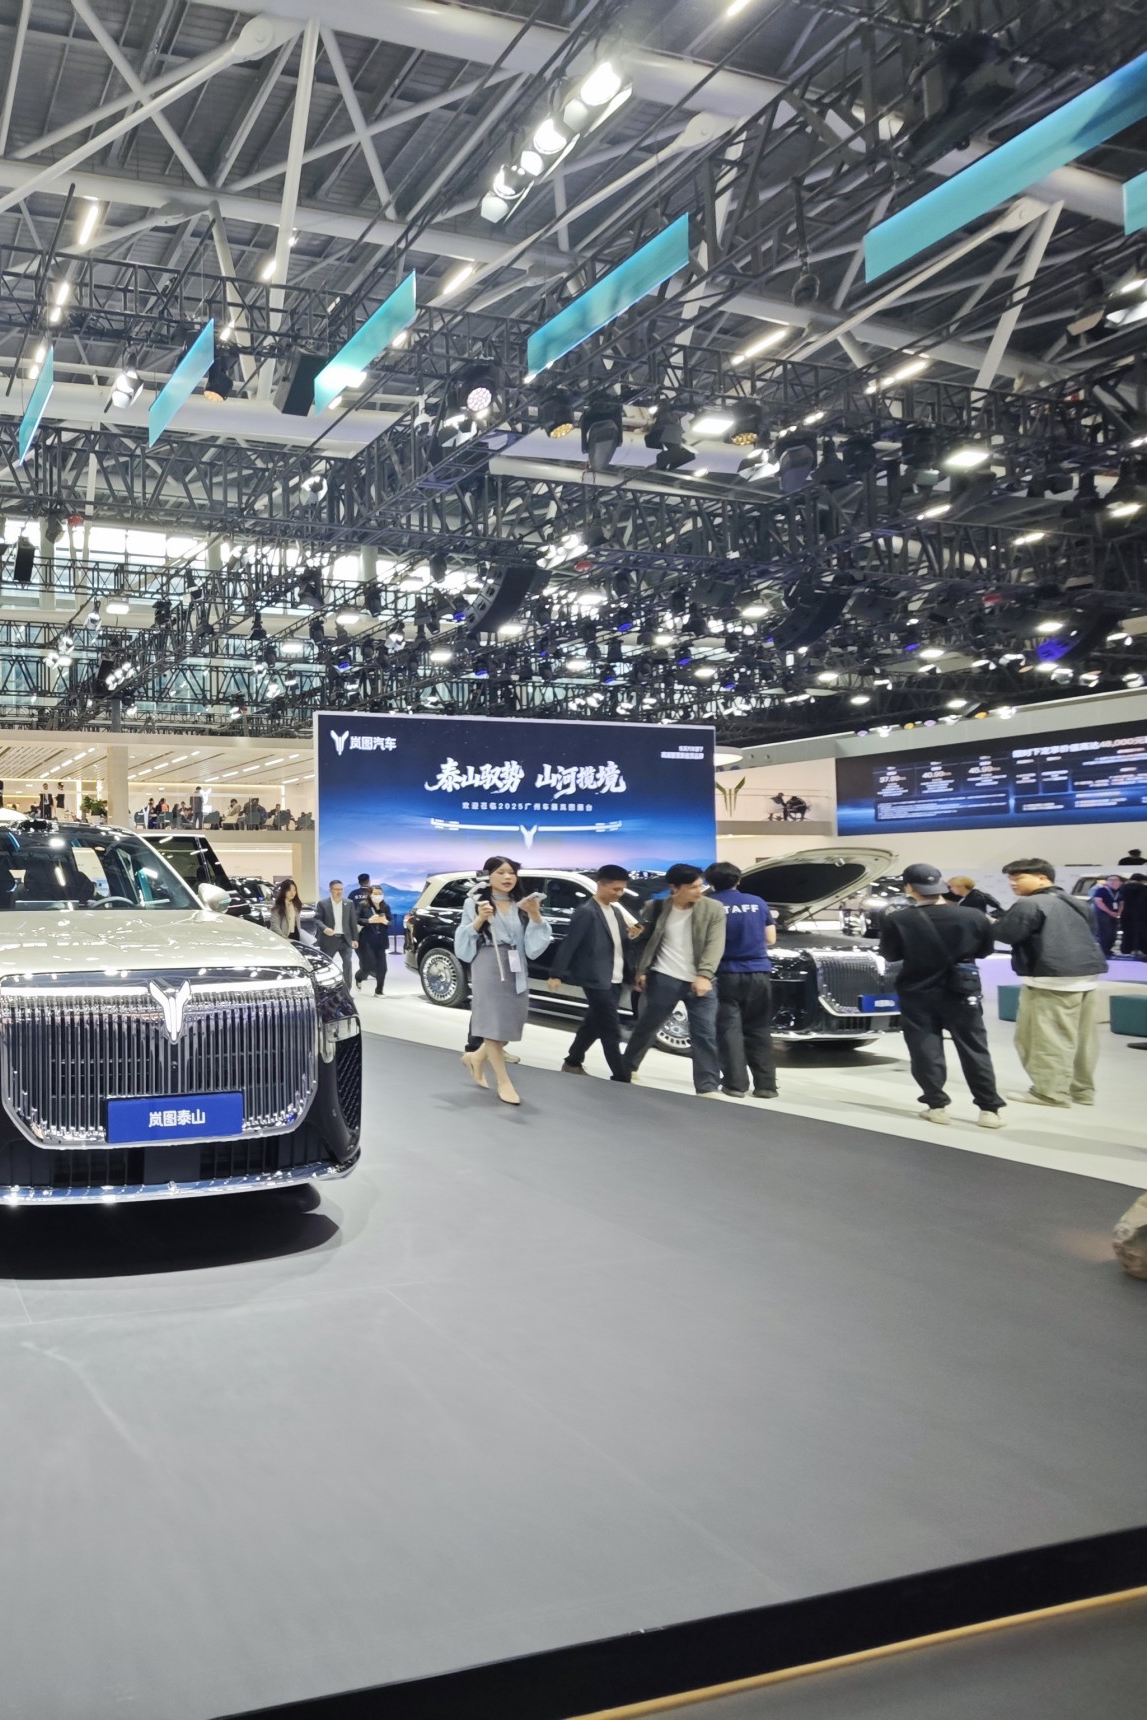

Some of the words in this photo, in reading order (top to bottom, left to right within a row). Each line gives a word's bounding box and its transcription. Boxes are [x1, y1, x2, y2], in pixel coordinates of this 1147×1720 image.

[349, 736, 397, 751] 岚图汽车
[148, 1109, 206, 1128] 岚图泰山
